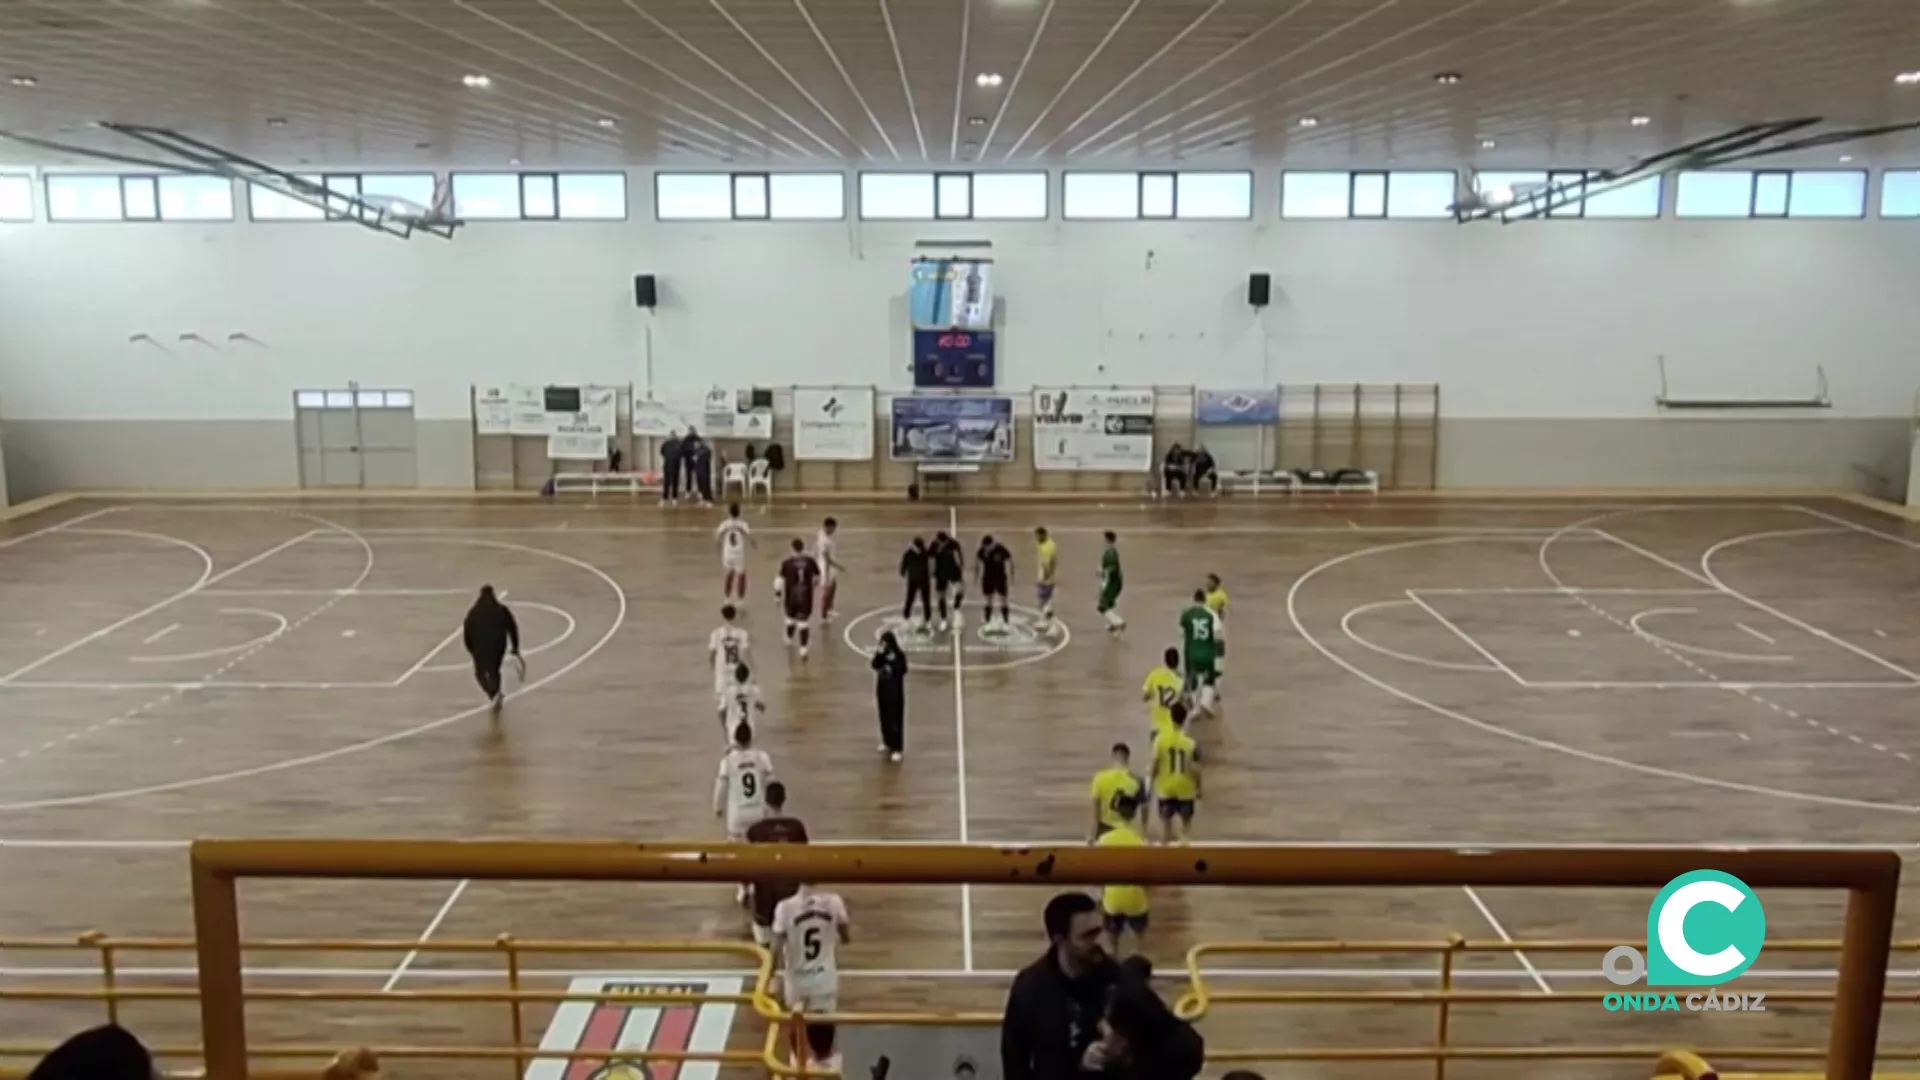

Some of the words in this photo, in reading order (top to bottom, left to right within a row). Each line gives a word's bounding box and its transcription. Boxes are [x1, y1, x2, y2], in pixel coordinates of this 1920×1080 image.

[1192, 618, 1209, 640] 15
[1158, 686, 1176, 707] 12
[1169, 747, 1186, 773] 11
[742, 771, 756, 798] 9
[804, 927, 821, 960] 5
